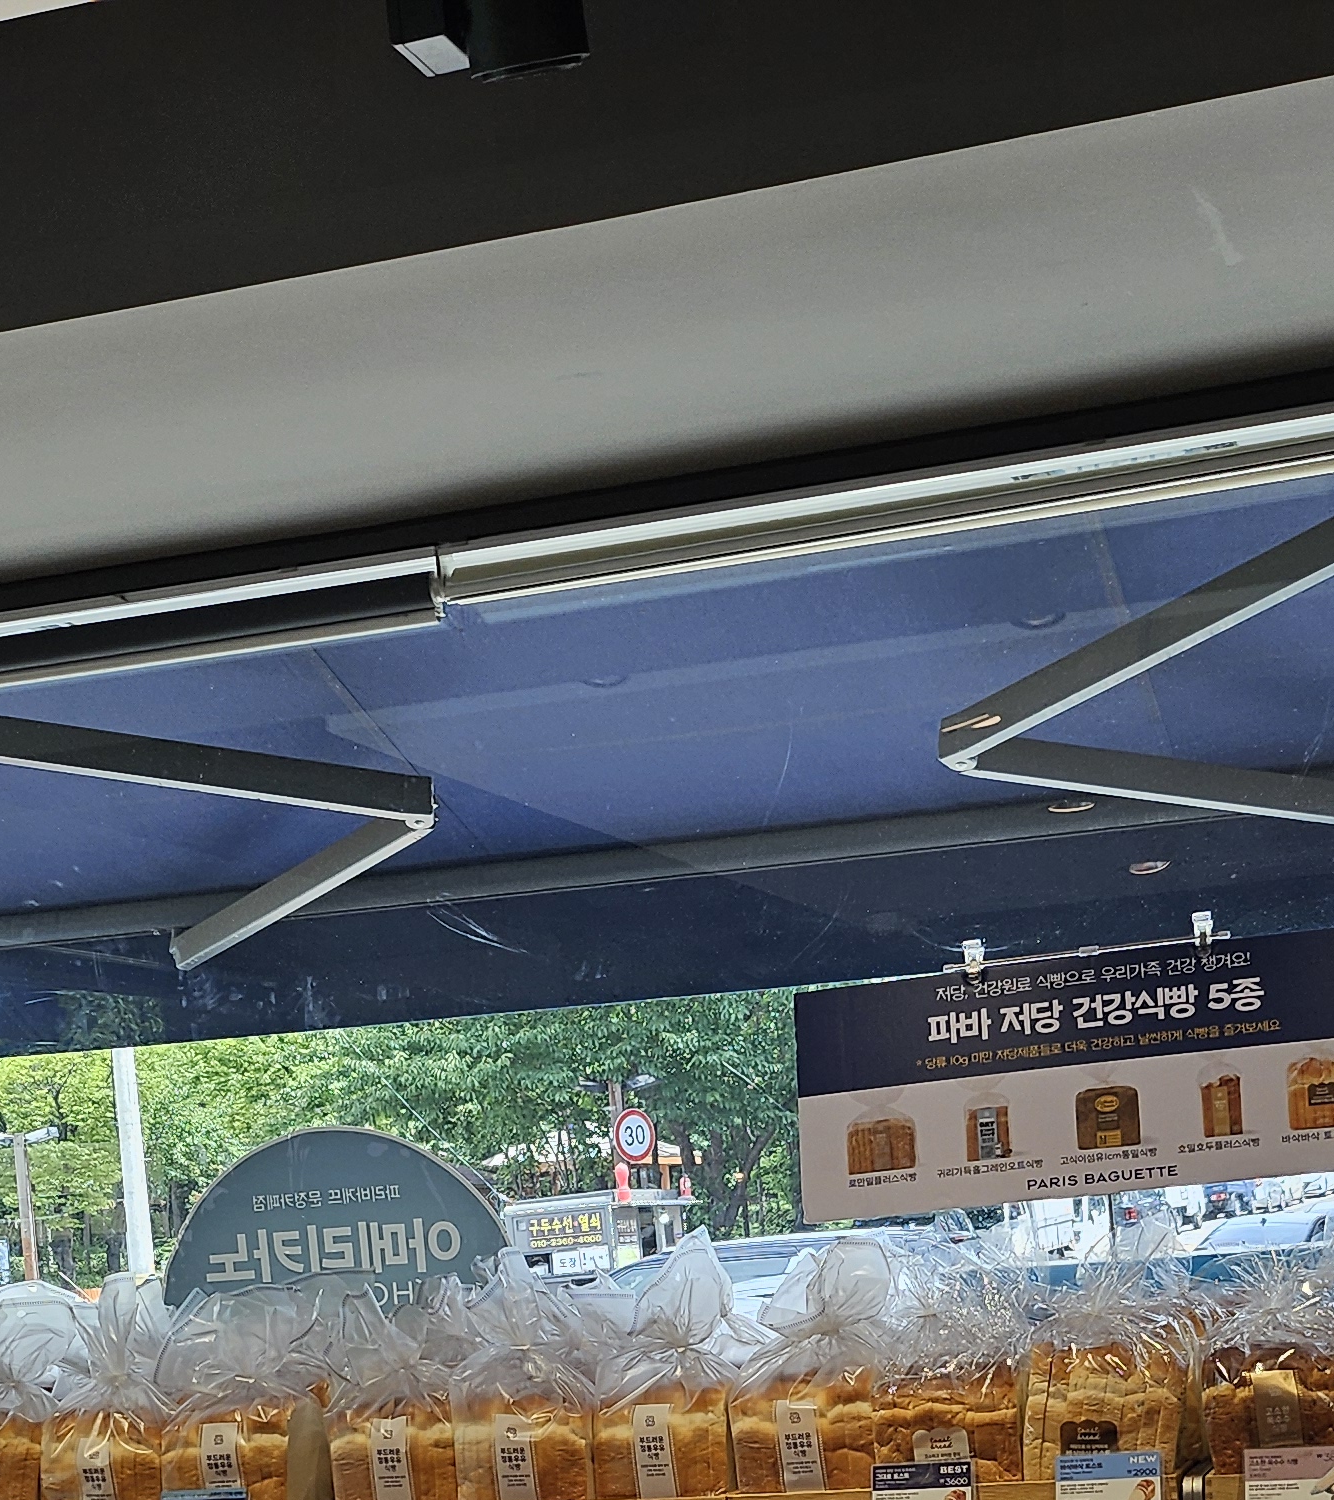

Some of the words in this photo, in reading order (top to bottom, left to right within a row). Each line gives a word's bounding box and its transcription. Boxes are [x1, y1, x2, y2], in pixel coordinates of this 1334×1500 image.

[974, 977, 1032, 999] 건강원료
[1036, 970, 1097, 991] 식빵으로
[1100, 963, 1161, 984] 우리가족
[1167, 957, 1196, 976] 건강
[927, 1009, 992, 1044] 파바
[1000, 1000, 1063, 1035] 저당
[1072, 985, 1199, 1029] 건강식빵
[1207, 976, 1265, 1012] 5종
[624, 1124, 646, 1147] 30
[1026, 1175, 1078, 1190] PARIS
[1084, 1165, 1178, 1185] BAGUETTE
[939, 1465, 969, 1474] BEST
[1129, 1455, 1157, 1464] NEW
